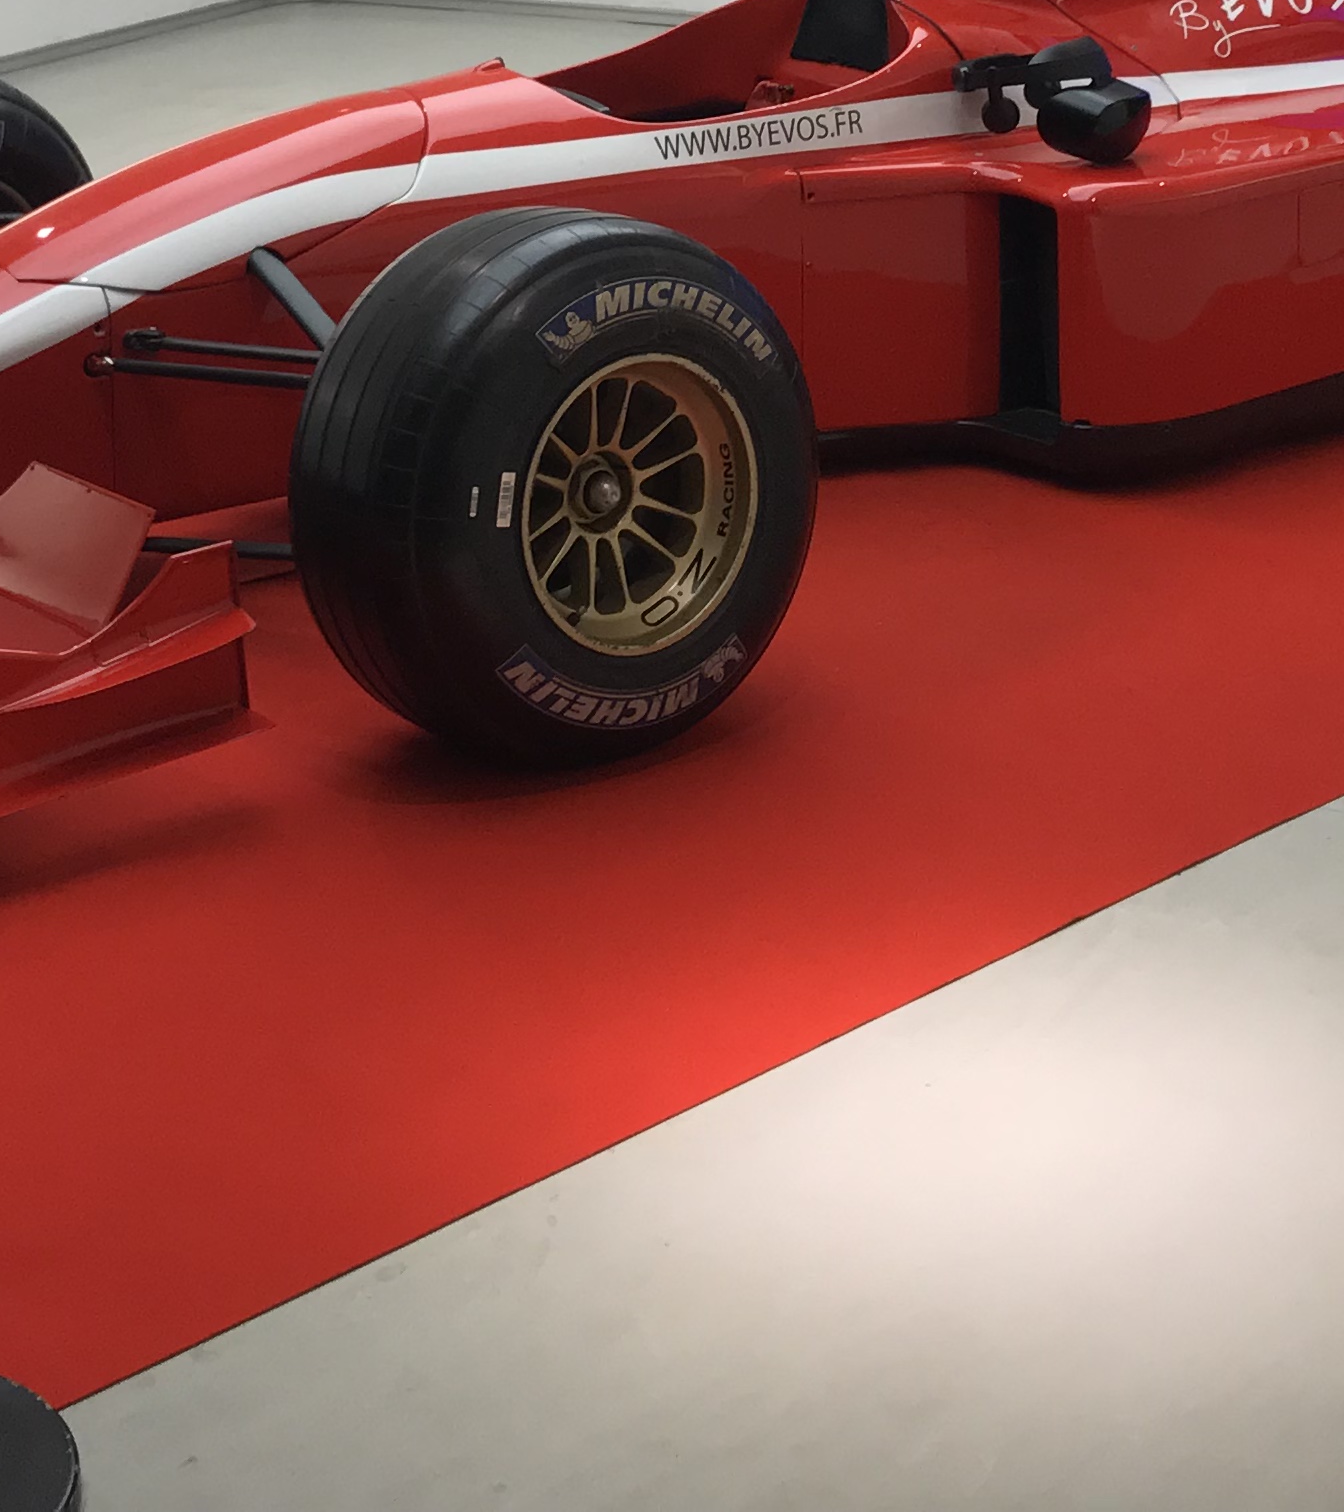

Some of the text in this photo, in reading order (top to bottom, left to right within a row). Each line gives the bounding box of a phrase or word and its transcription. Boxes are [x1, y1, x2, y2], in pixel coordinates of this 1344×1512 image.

[653, 109, 864, 160] WWW.BYEVOS.FR
[594, 280, 776, 363] MICHELIN
[717, 442, 735, 538] RACING
[502, 657, 700, 730] MICHELIN
